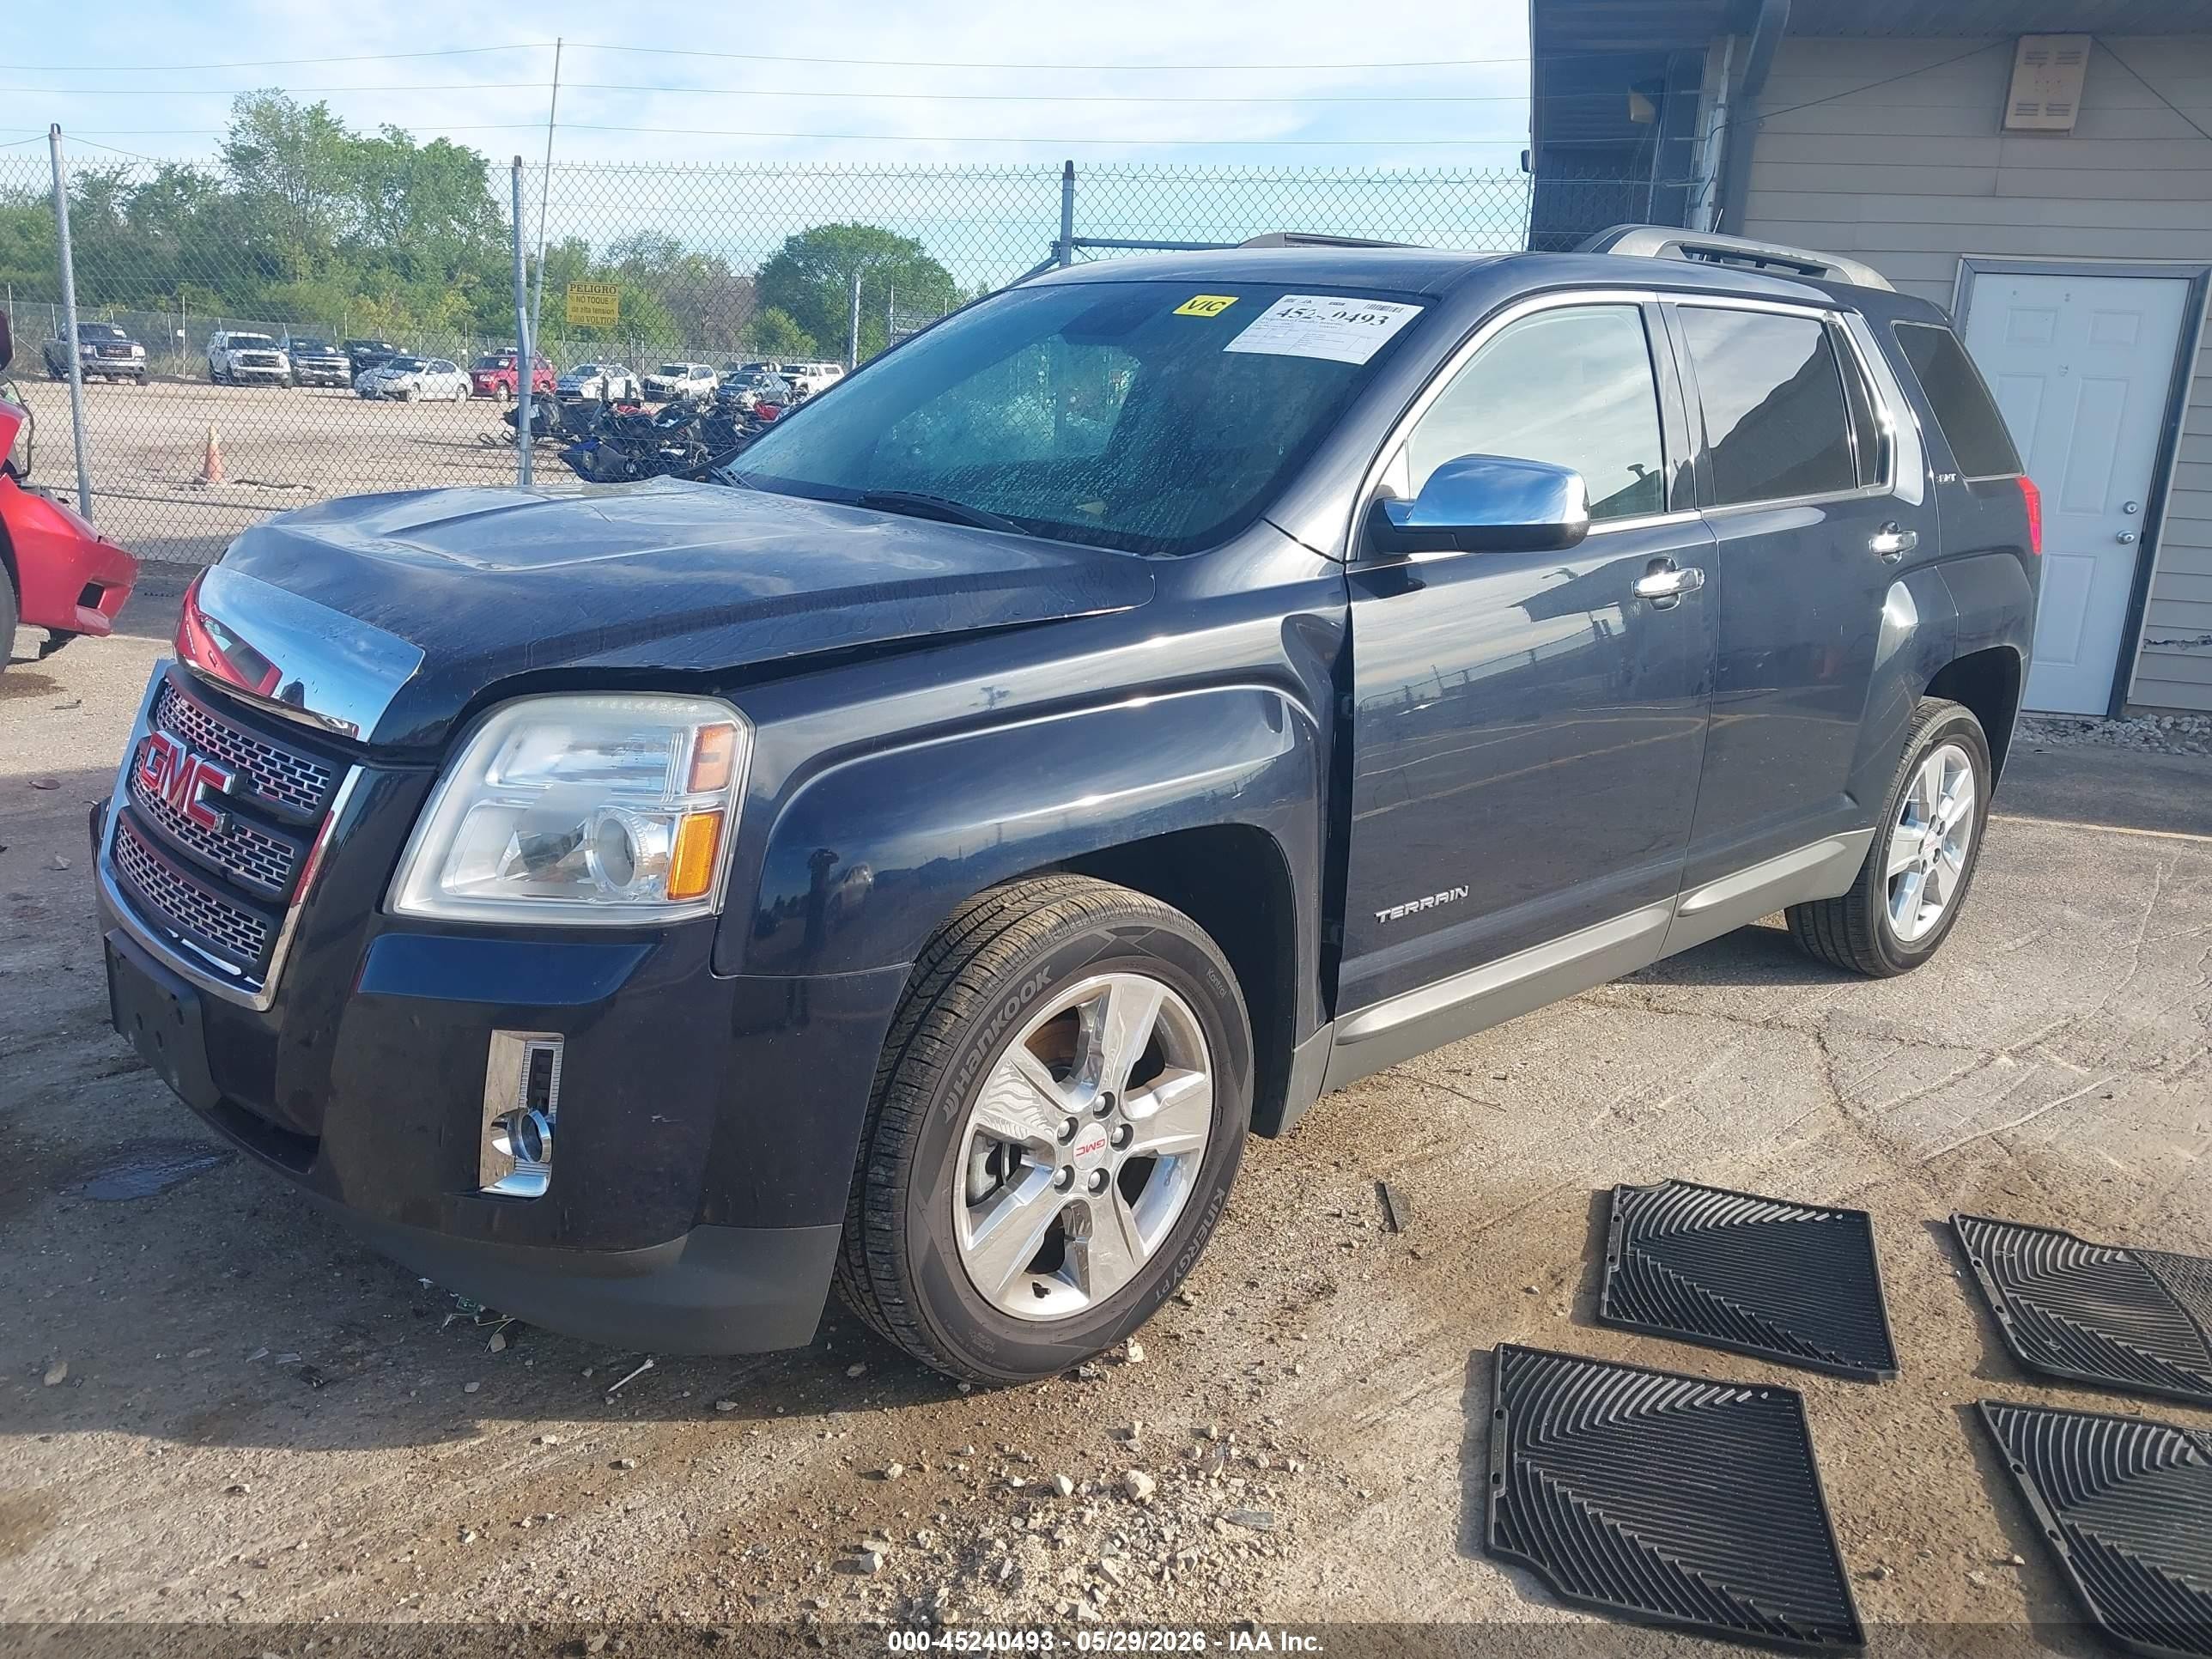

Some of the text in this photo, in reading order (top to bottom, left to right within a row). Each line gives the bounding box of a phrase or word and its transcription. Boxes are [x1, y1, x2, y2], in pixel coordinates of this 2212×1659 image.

[570, 283, 617, 295] PELIGRO
[587, 295, 609, 305] TOQUE
[1188, 300, 1226, 312] VIC
[586, 315, 617, 324] VOLTIOS
[141, 730, 235, 833] GMC
[1374, 885, 1469, 924] TERRAIN
[1075, 1138, 1106, 1158] GMC
[1155, 1279, 1170, 1303] PT
